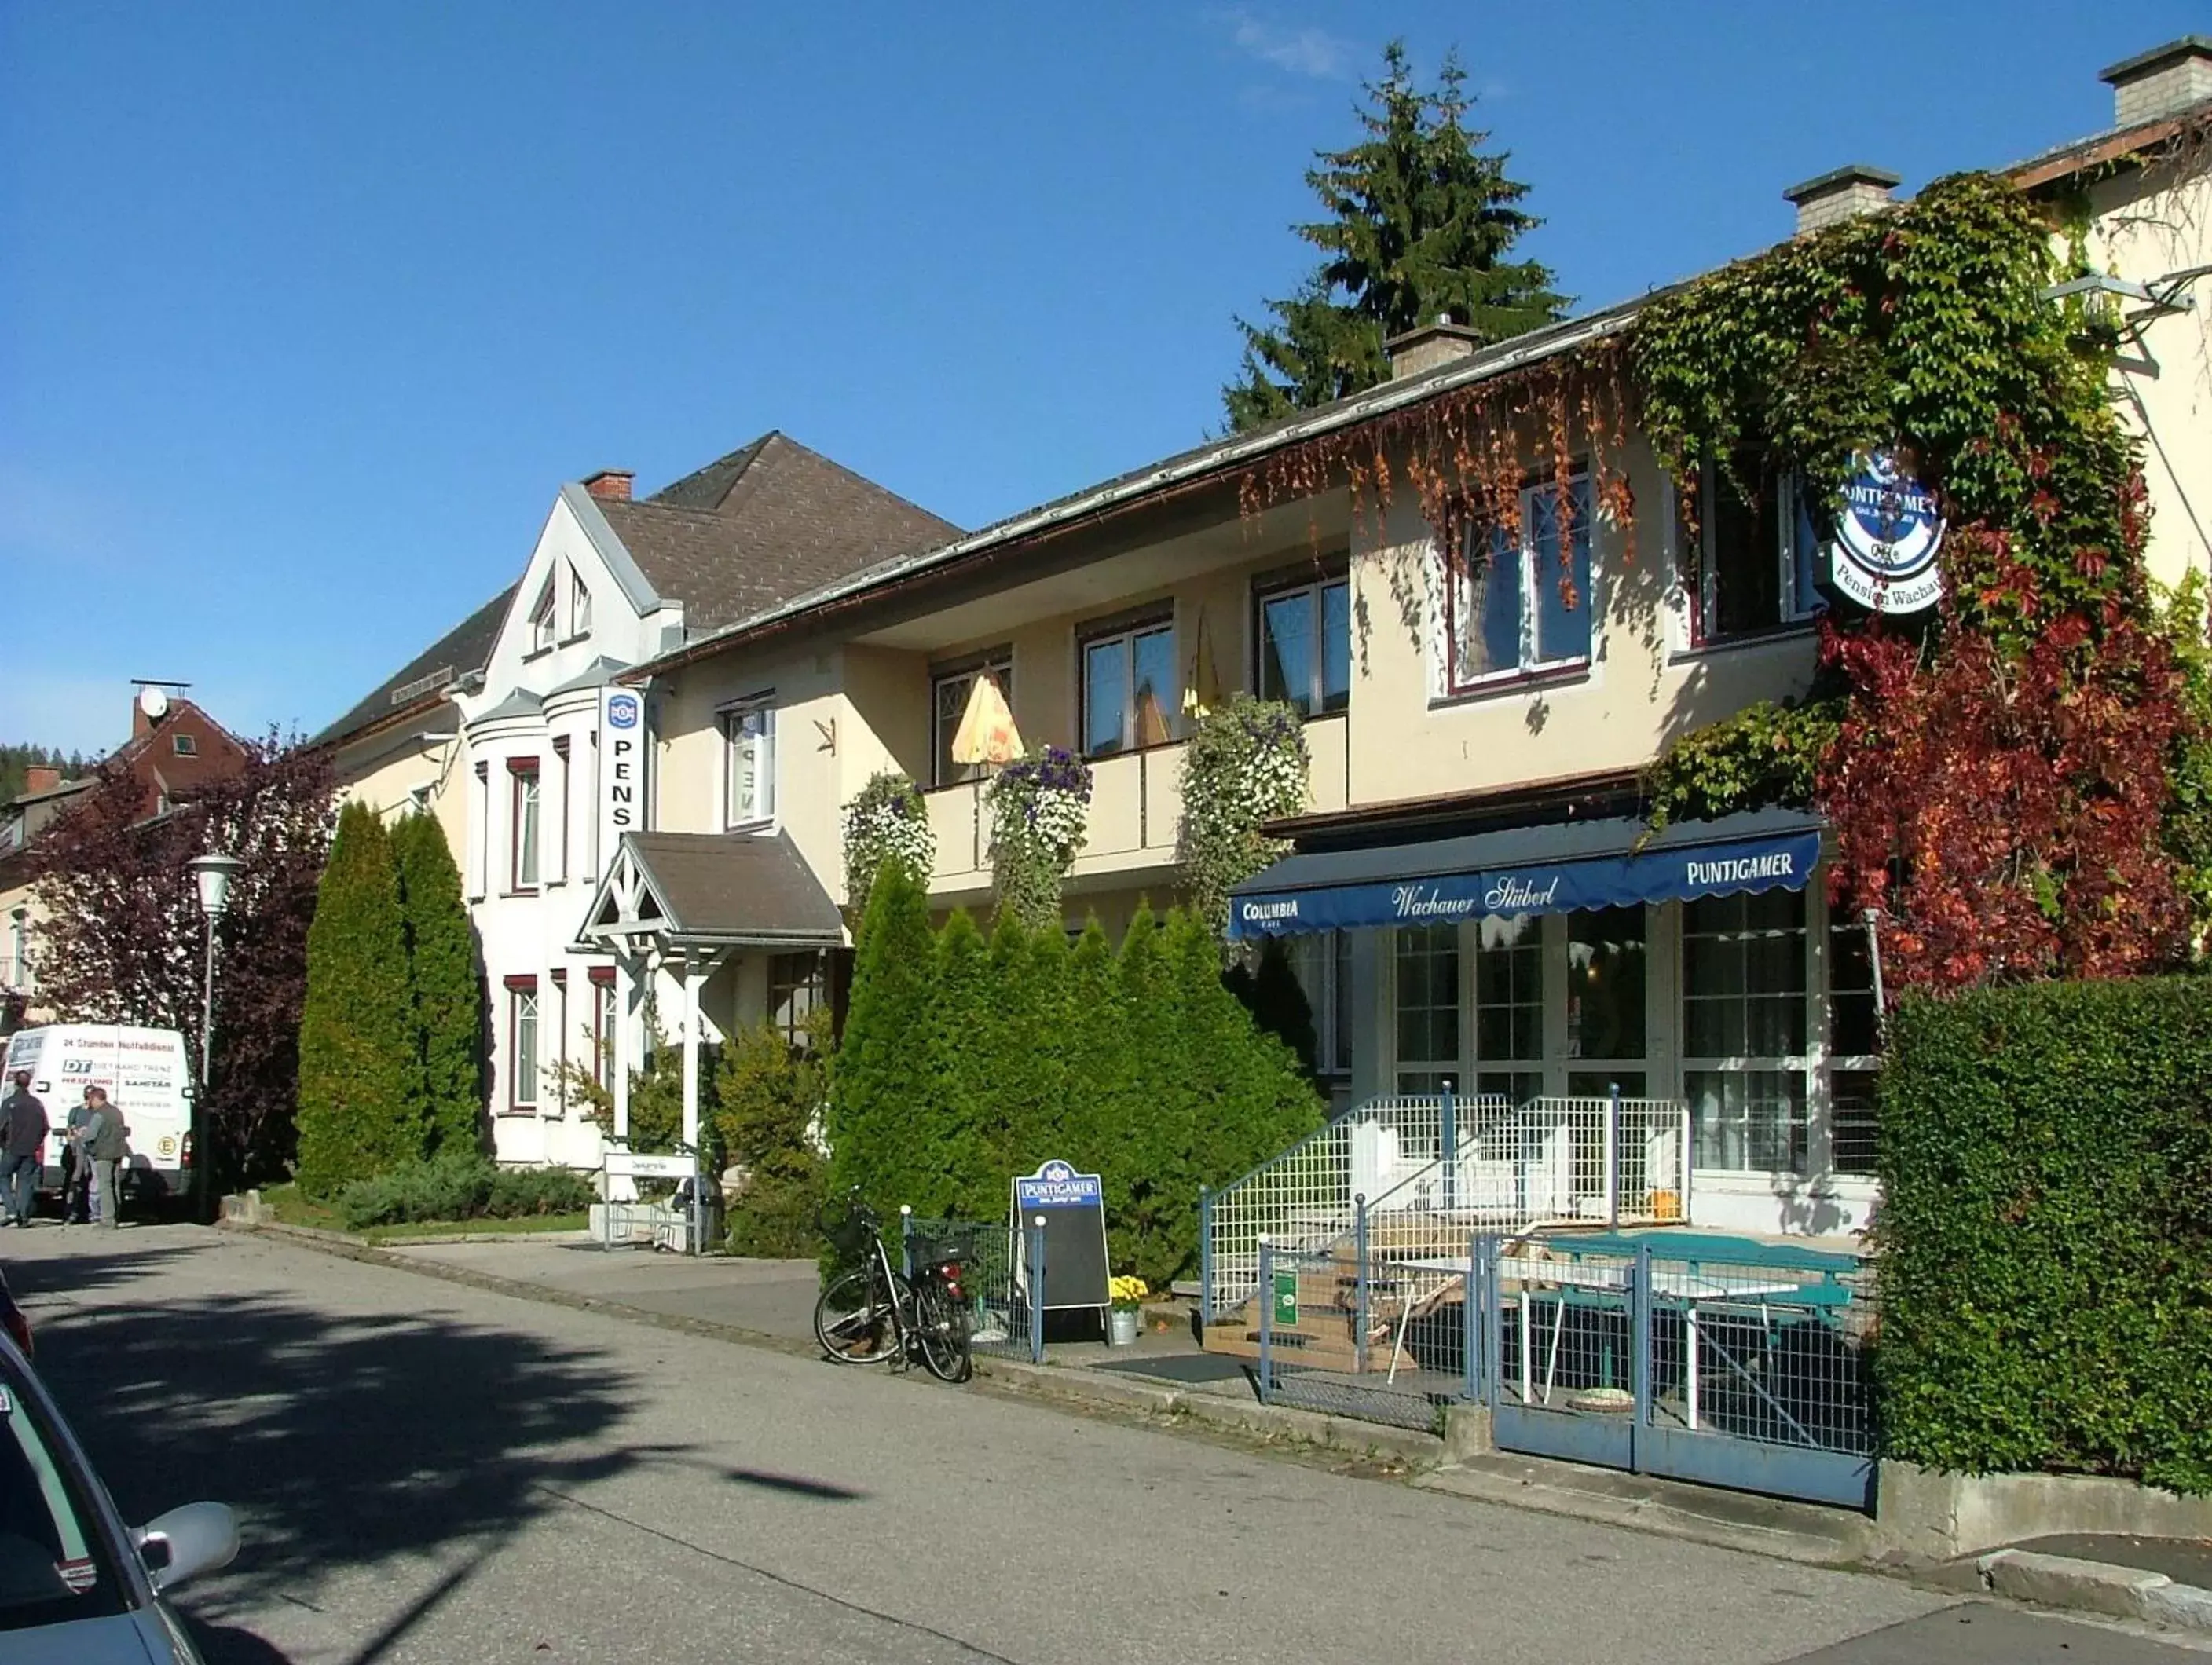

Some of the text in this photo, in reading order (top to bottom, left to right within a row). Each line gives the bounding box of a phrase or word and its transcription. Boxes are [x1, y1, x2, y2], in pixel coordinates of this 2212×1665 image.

[1837, 564, 1890, 605] Pensin
[1687, 853, 1793, 885] PUNTIGAMER
[1243, 899, 1298, 920] COLUMBIA
[1391, 876, 1559, 918] Wachauer Stüberl
[1024, 1181, 1094, 1196] PUNTIGAMER
